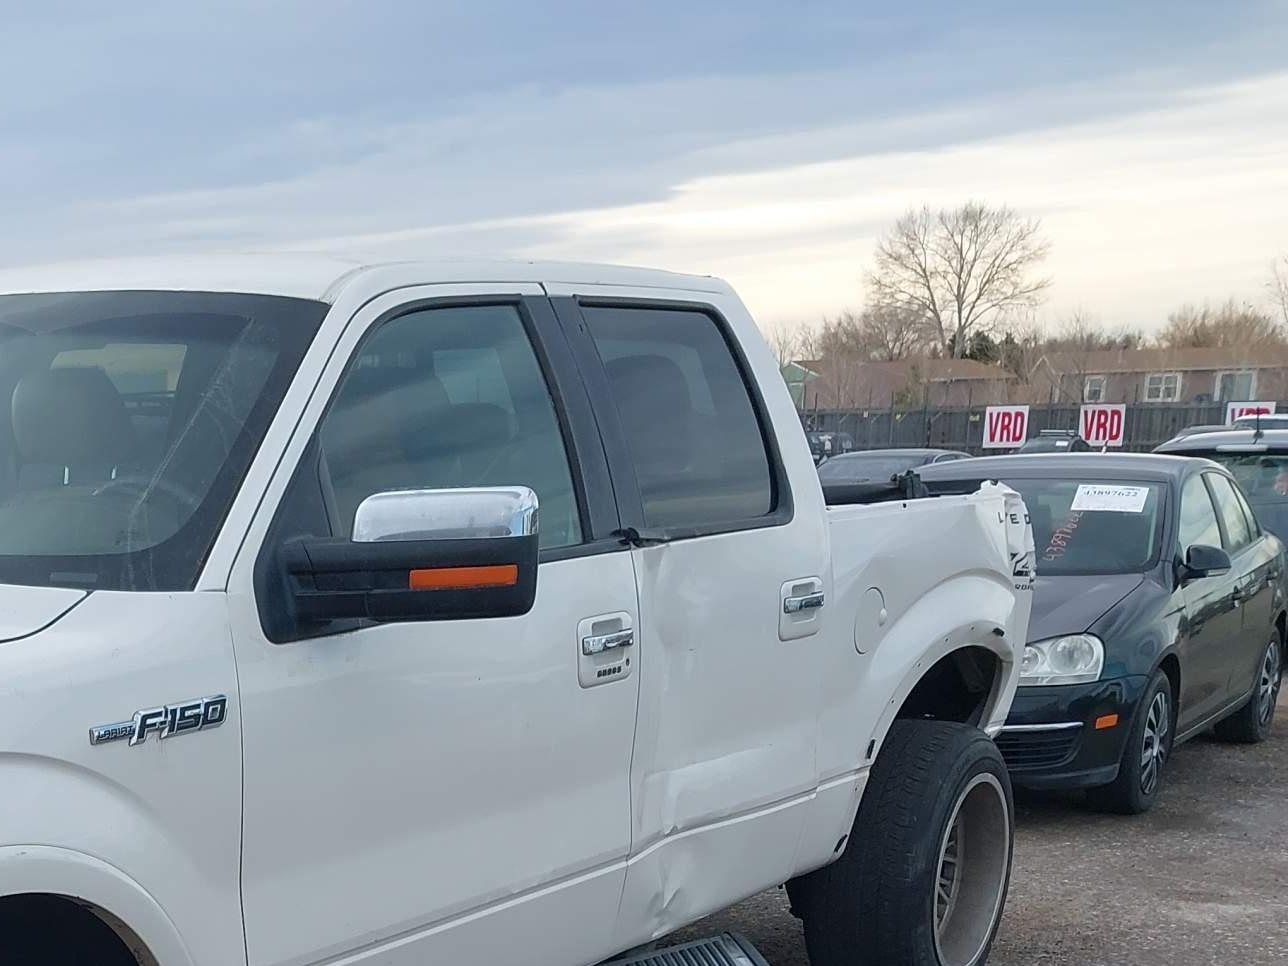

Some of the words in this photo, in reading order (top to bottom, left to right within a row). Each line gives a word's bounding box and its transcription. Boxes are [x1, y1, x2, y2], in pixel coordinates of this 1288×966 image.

[988, 410, 1025, 443] VRD
[1083, 408, 1122, 442] VRD
[96, 724, 135, 742] LARIAT
